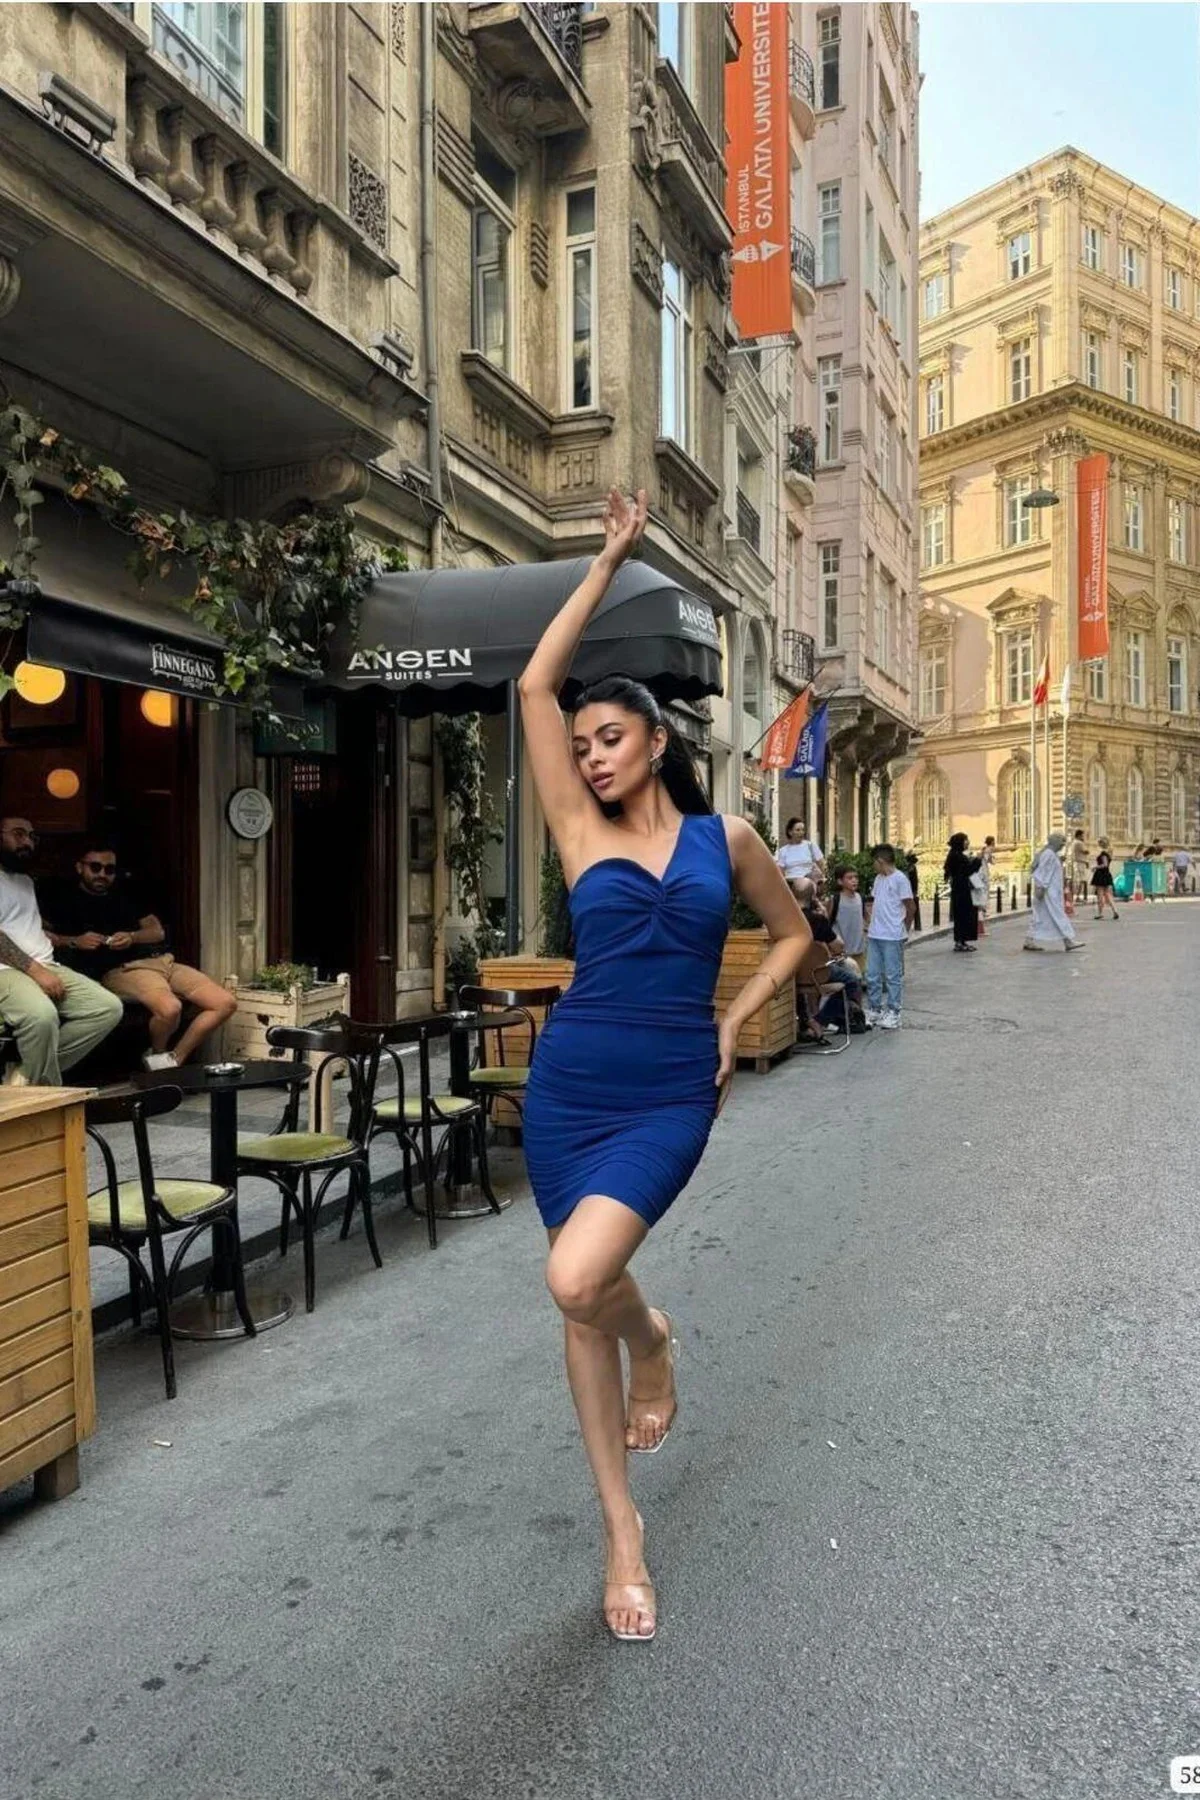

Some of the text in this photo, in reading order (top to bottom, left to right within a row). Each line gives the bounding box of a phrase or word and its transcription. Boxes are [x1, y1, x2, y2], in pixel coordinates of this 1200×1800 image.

[754, 136, 772, 229] GALATA
[151, 643, 216, 681] FINNEGANS
[385, 670, 432, 680] SUITES
